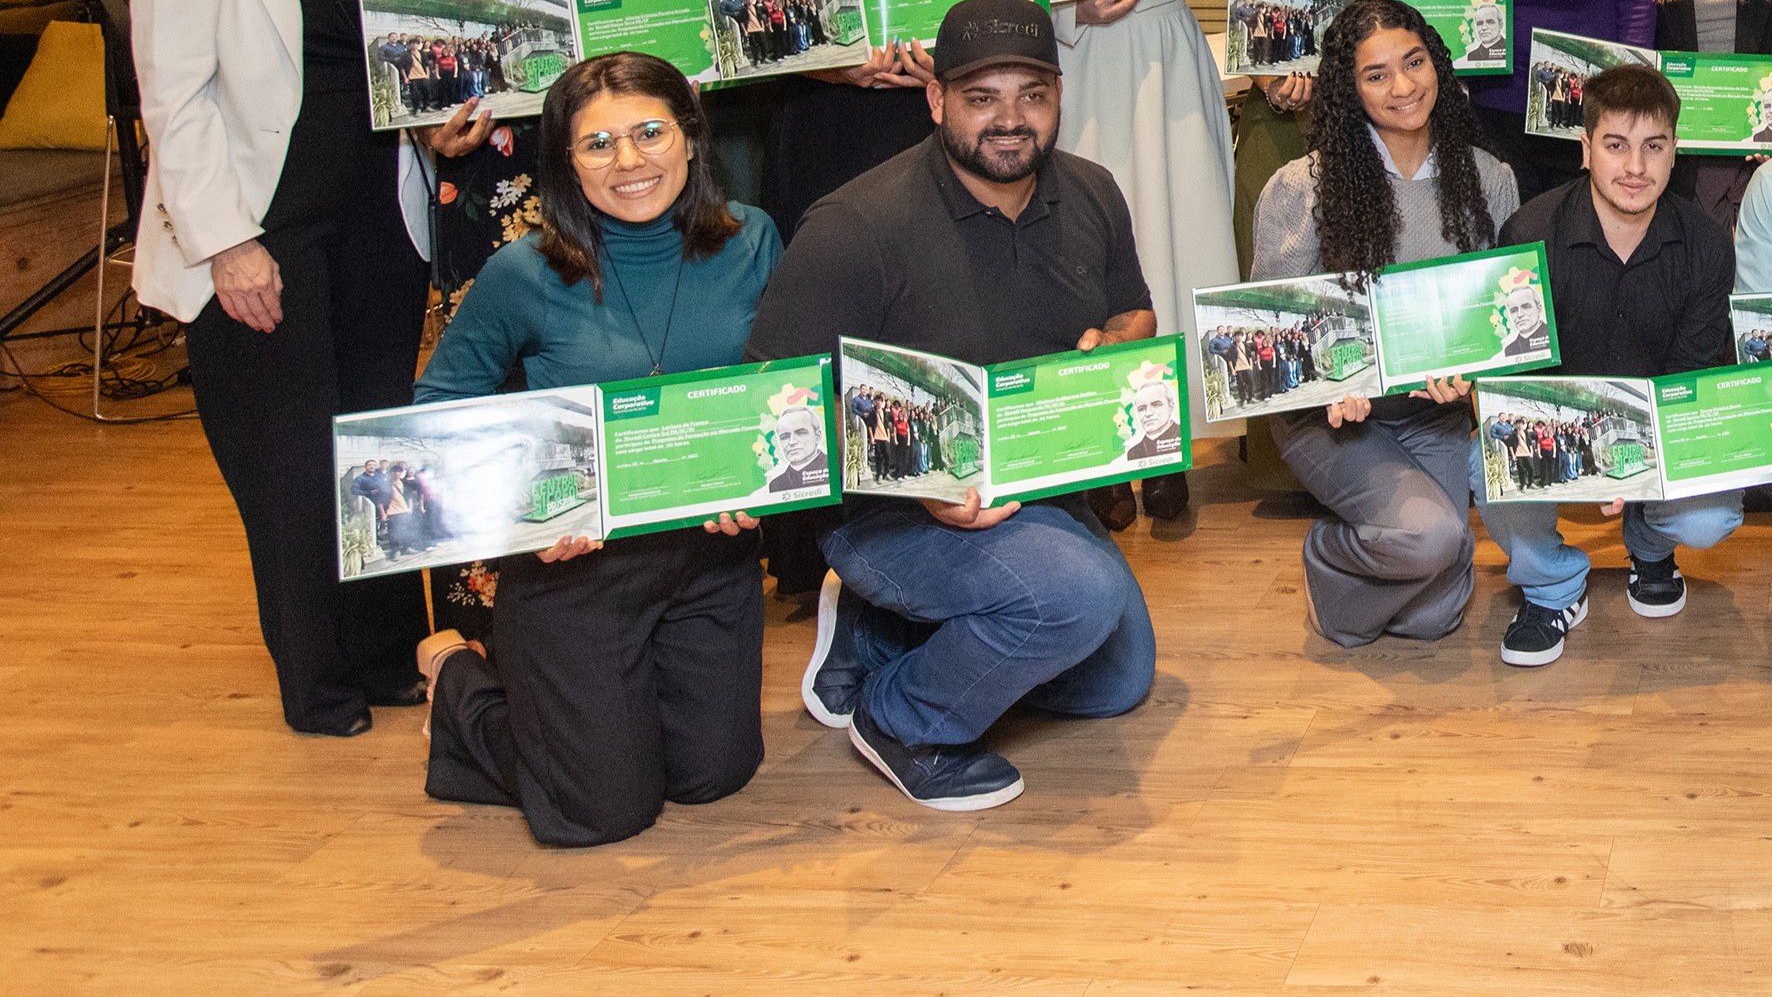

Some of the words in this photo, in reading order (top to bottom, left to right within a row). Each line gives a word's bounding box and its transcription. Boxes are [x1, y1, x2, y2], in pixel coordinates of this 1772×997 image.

[1058, 361, 1110, 376] CERTIFICADO
[995, 373, 1023, 382] Educação
[995, 378, 1030, 388] Corporativa
[1717, 377, 1762, 390] CERTIFICADO
[687, 384, 747, 400] CERTIFICADO
[613, 394, 646, 404] Educação
[613, 400, 655, 410] Corporativa
[793, 489, 822, 499] Sicredi
